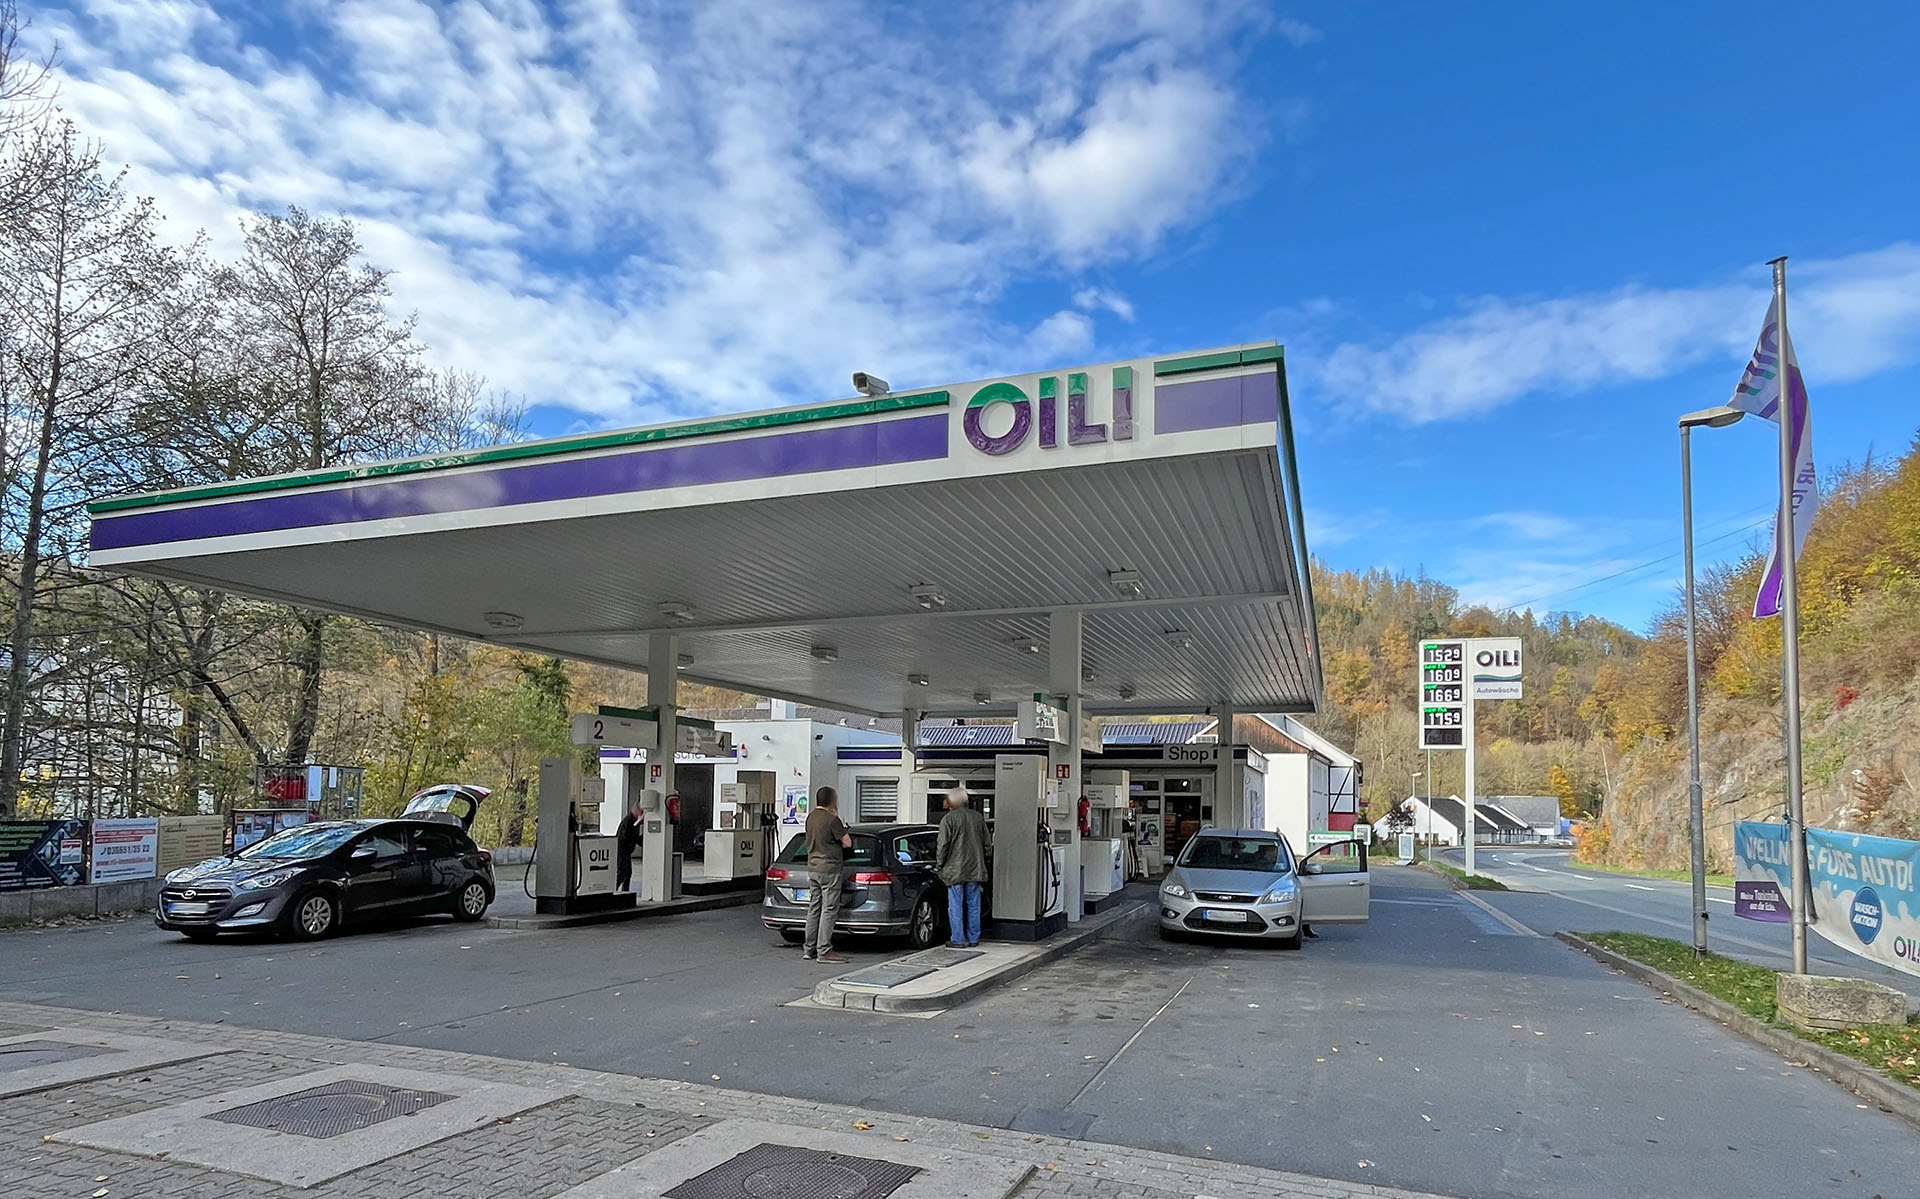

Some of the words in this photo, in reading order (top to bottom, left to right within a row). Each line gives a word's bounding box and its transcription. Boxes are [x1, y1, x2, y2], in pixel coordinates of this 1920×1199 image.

[963, 365, 1133, 456] OIL!
[1476, 650, 1520, 667] OIL!
[593, 720, 604, 740] 2
[718, 735, 725, 751] 4
[1168, 746, 1209, 763] Shop
[740, 840, 754, 850] OIL!
[589, 849, 609, 861] OIL!
[1745, 836, 1816, 870] WELLNS
[1817, 843, 1858, 880] FÜRS
[1860, 855, 1914, 892] AUTO!
[1853, 913, 1878, 928] AKTION
